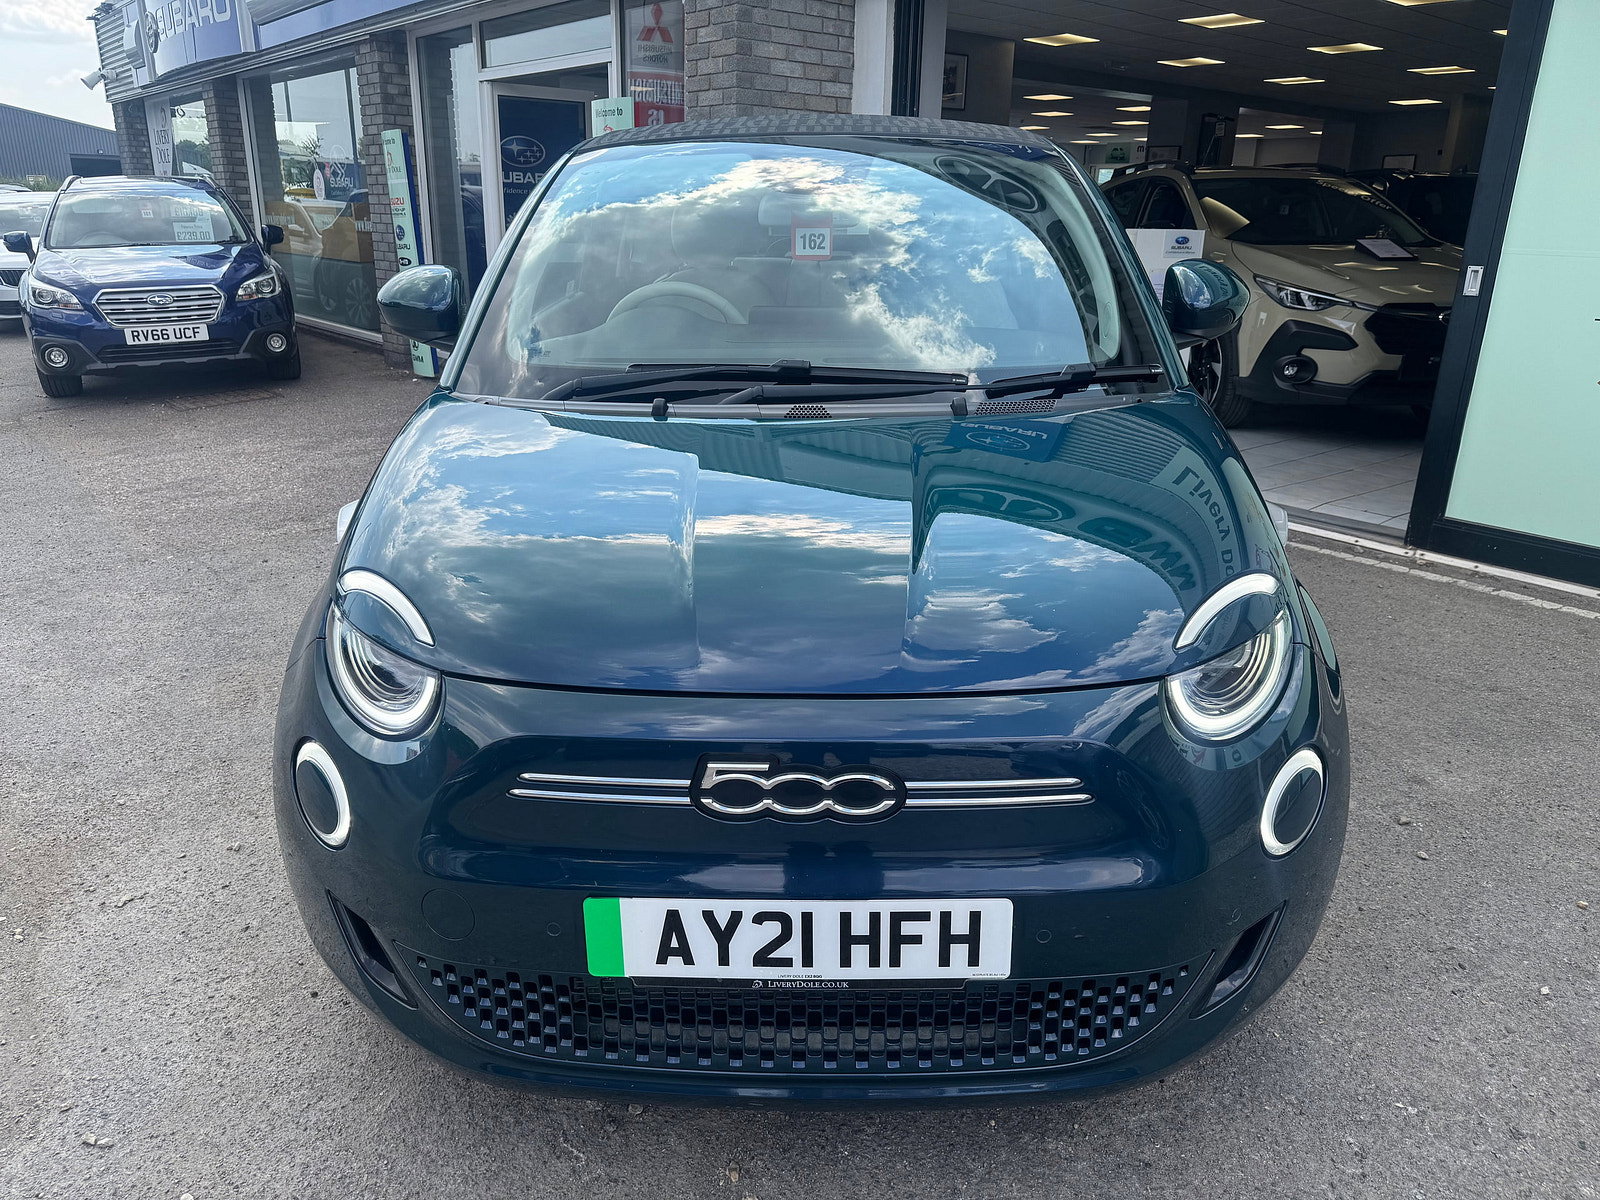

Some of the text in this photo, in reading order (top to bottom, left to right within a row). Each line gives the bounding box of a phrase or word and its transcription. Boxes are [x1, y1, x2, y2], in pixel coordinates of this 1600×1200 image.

[156, 0, 231, 42] SUBARU
[595, 107, 624, 118] Welcome to
[156, 147, 171, 164] DOLE
[176, 230, 211, 241] £239.00
[800, 232, 826, 251] 162
[131, 326, 201, 342] RV66 UCF
[700, 762, 896, 815] 500
[655, 909, 982, 968] AY21 HFH
